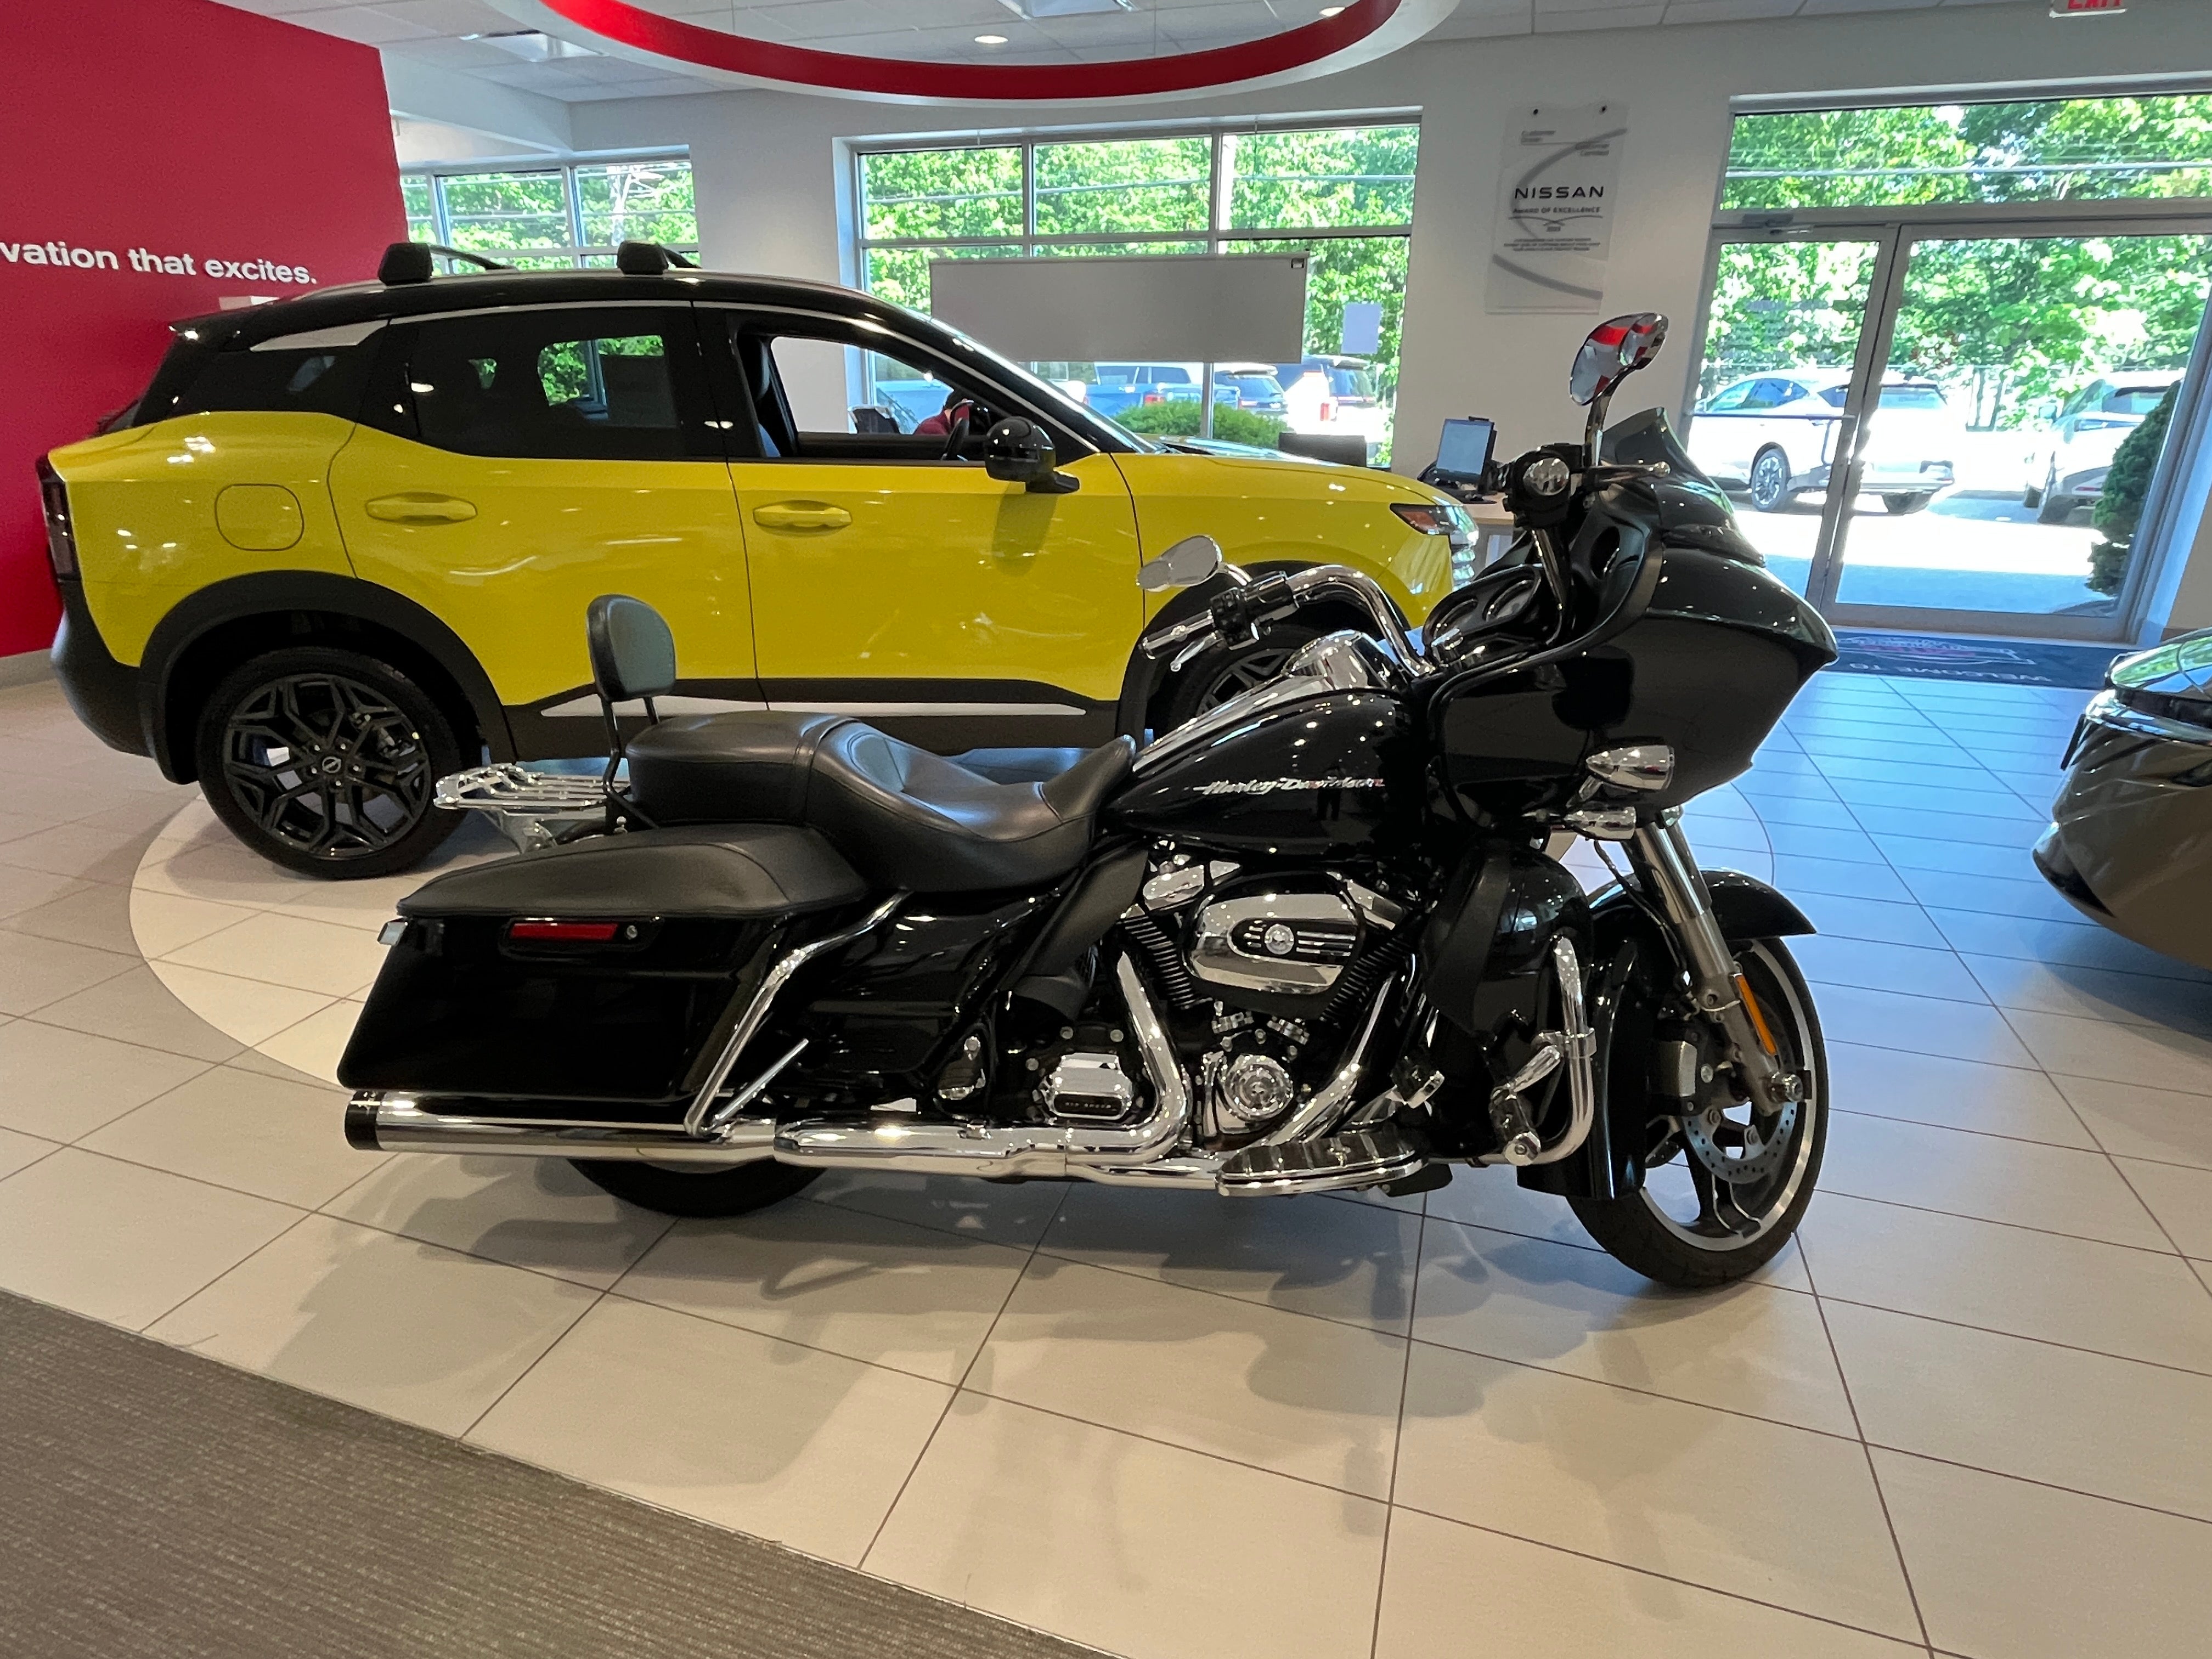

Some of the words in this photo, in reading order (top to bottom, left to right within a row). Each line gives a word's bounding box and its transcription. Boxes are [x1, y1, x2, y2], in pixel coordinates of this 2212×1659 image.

[1514, 185, 1604, 199] NISSAN
[0, 241, 120, 270] vation
[127, 247, 197, 275] that
[205, 258, 318, 285] excites.
